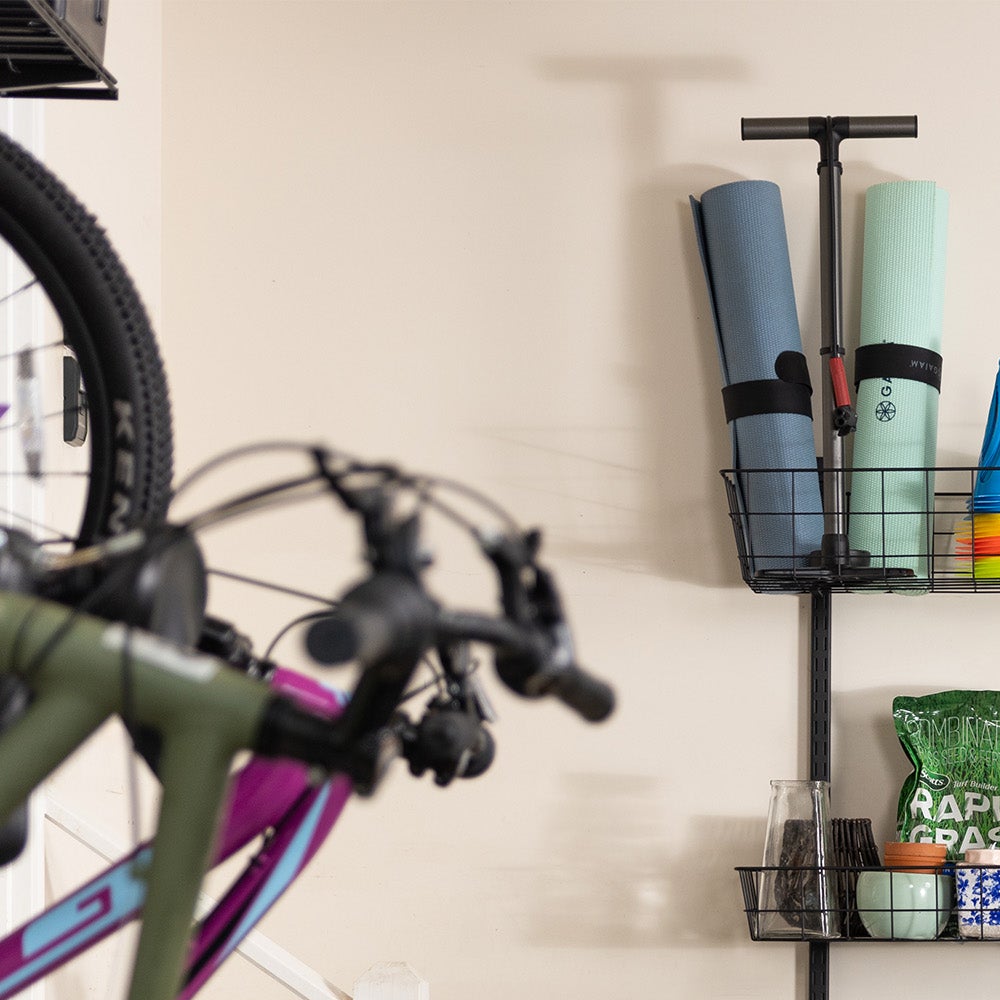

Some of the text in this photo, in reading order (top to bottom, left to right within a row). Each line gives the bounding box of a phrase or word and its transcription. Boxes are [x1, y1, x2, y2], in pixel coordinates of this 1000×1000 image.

[911, 360, 938, 375] GAIAM
[919, 769, 945, 786] Scotts
[953, 780, 999, 791] Turf Builder
